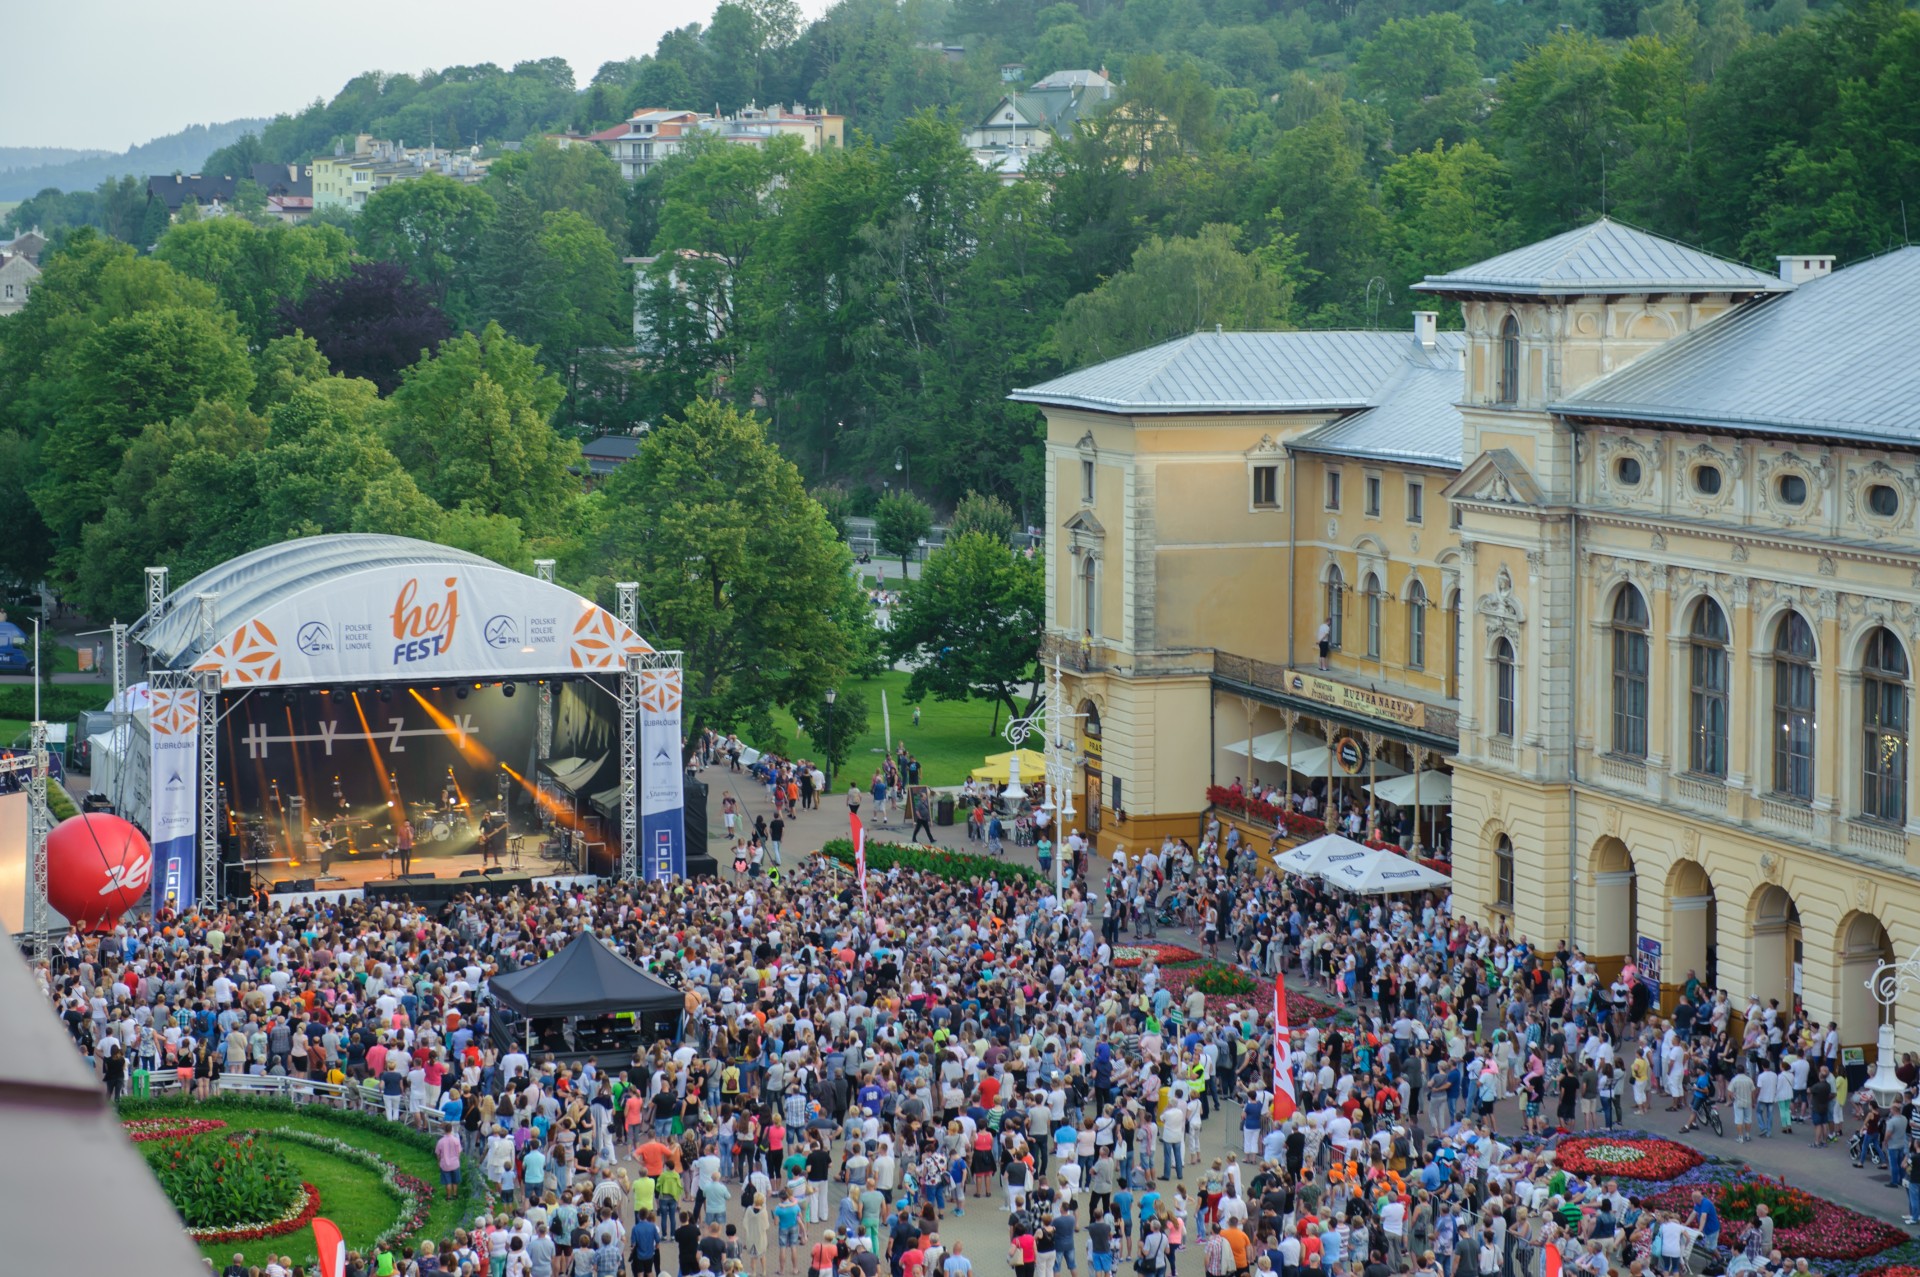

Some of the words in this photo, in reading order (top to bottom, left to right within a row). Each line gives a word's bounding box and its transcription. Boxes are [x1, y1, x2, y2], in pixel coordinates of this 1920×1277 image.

[390, 577, 460, 653] hej
[345, 642, 372, 650] LINOWE
[393, 634, 444, 665] FEST
